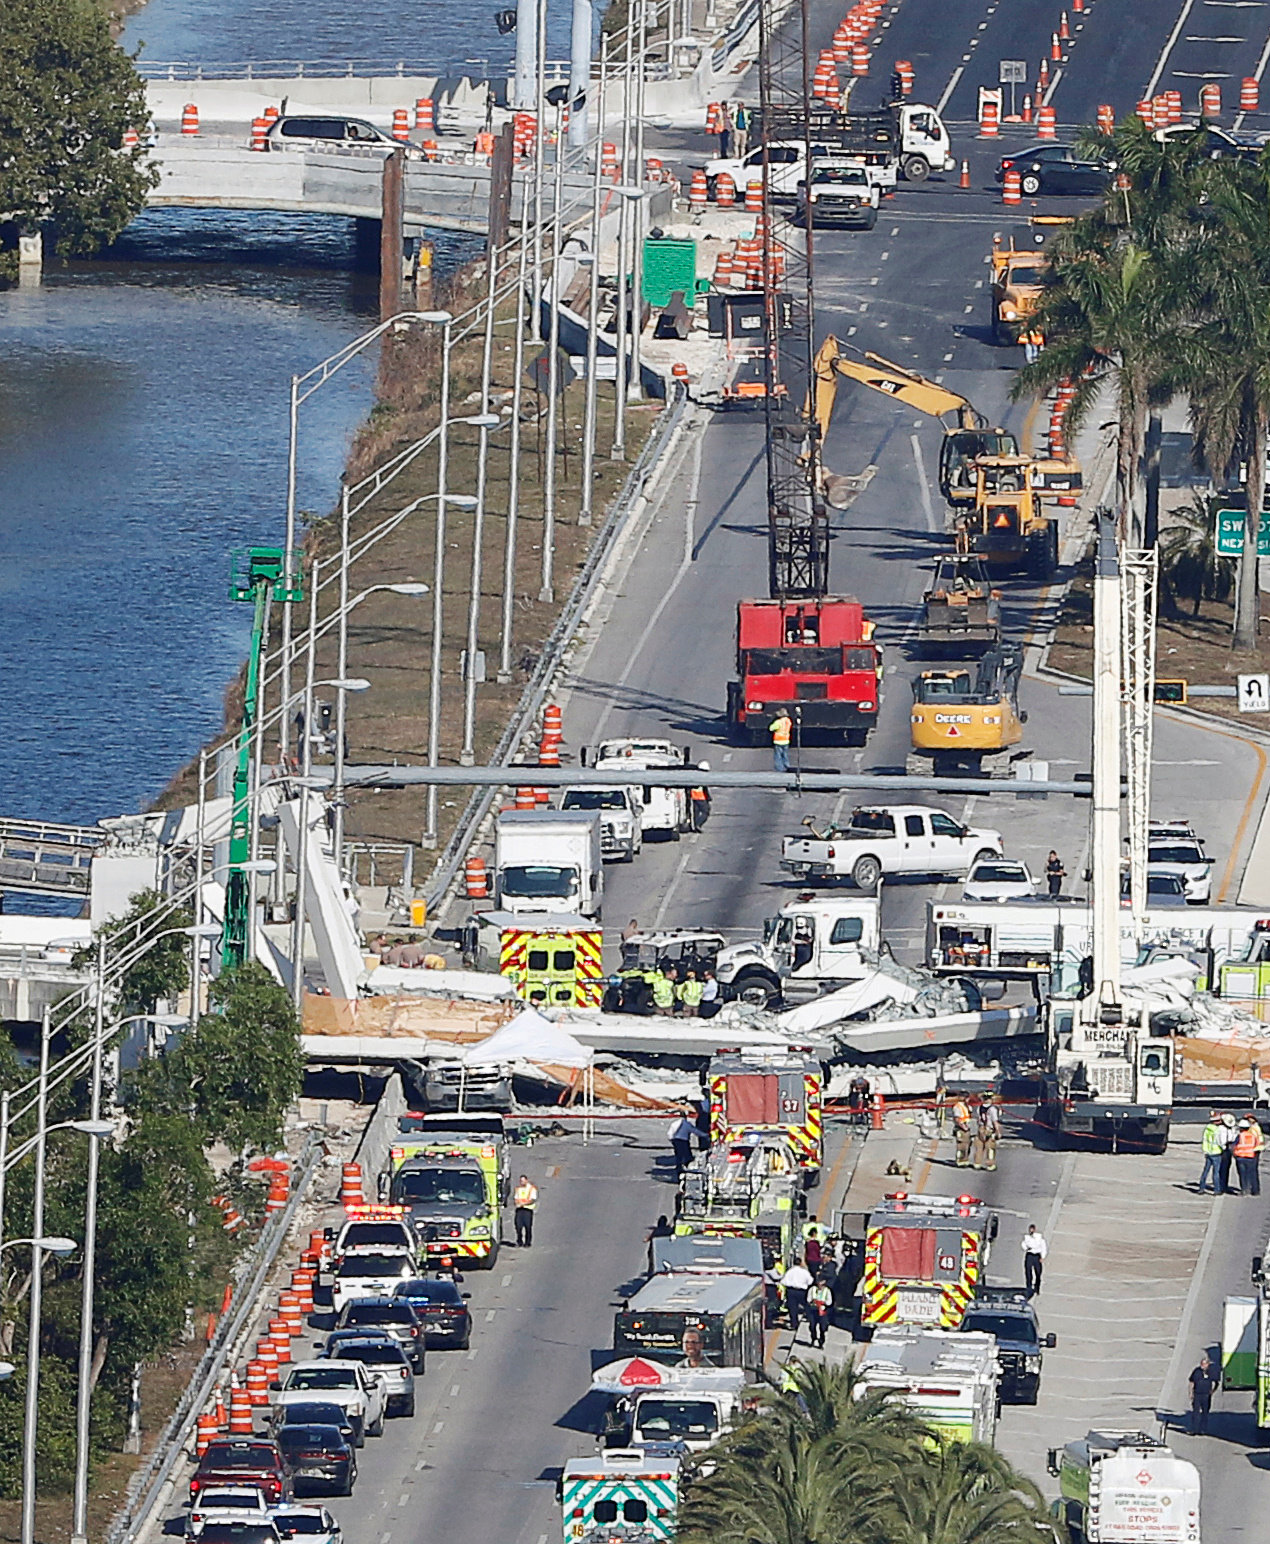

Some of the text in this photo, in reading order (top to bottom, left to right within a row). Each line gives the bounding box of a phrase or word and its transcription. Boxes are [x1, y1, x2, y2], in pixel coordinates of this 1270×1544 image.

[881, 380, 897, 392] CAT
[1222, 520, 1243, 532] SW
[1221, 538, 1244, 549] NEX
[935, 713, 972, 724] DEERE
[784, 1100, 798, 1112] 37
[1128, 1515, 1159, 1523] STOPS
